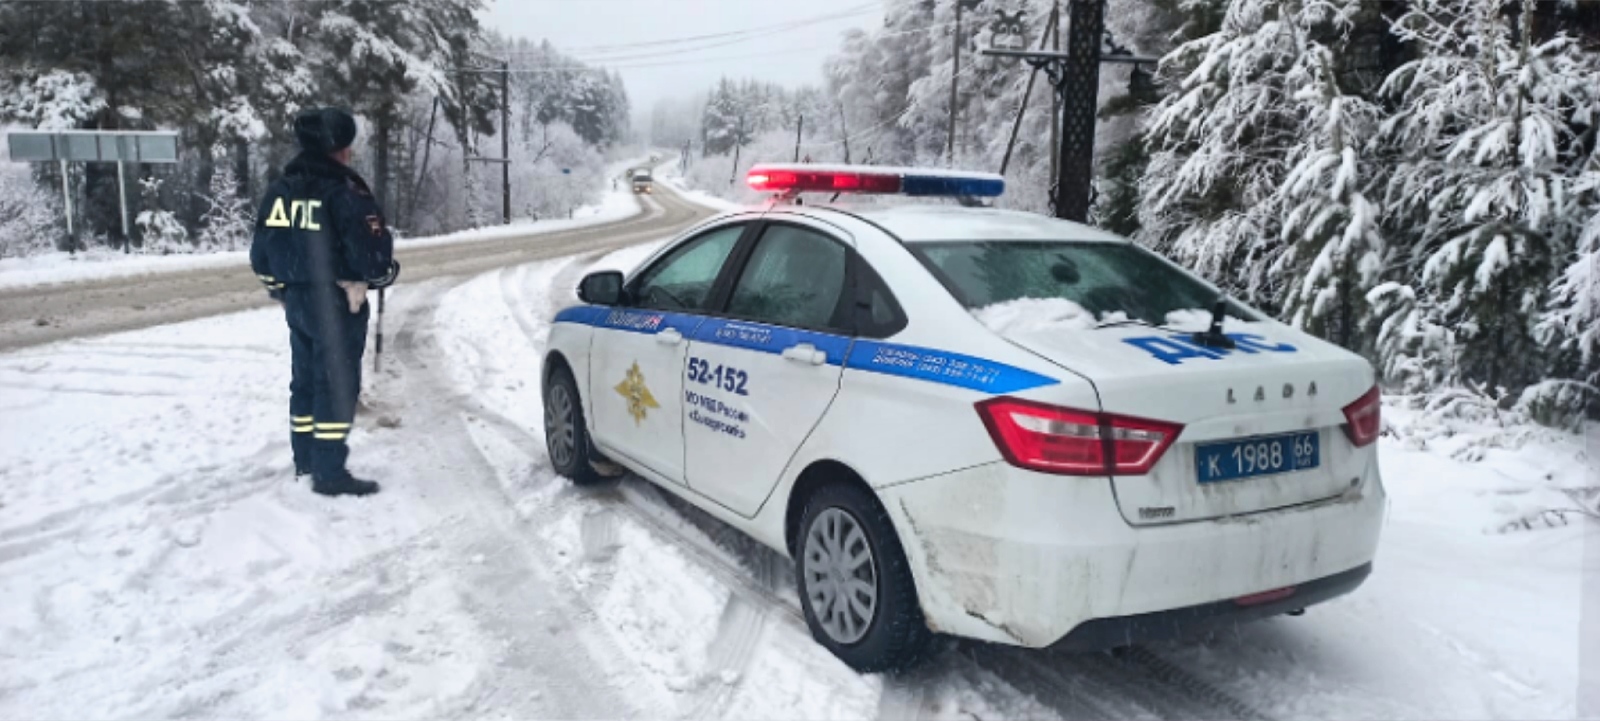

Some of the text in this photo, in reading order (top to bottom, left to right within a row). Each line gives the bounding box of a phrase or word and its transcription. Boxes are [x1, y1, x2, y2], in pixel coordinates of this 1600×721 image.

[266, 196, 322, 231] ДПС
[687, 357, 748, 396] 52-152
[1227, 380, 1318, 405] LADA
[1232, 440, 1284, 474] 1988
[1294, 434, 1313, 457] 66
